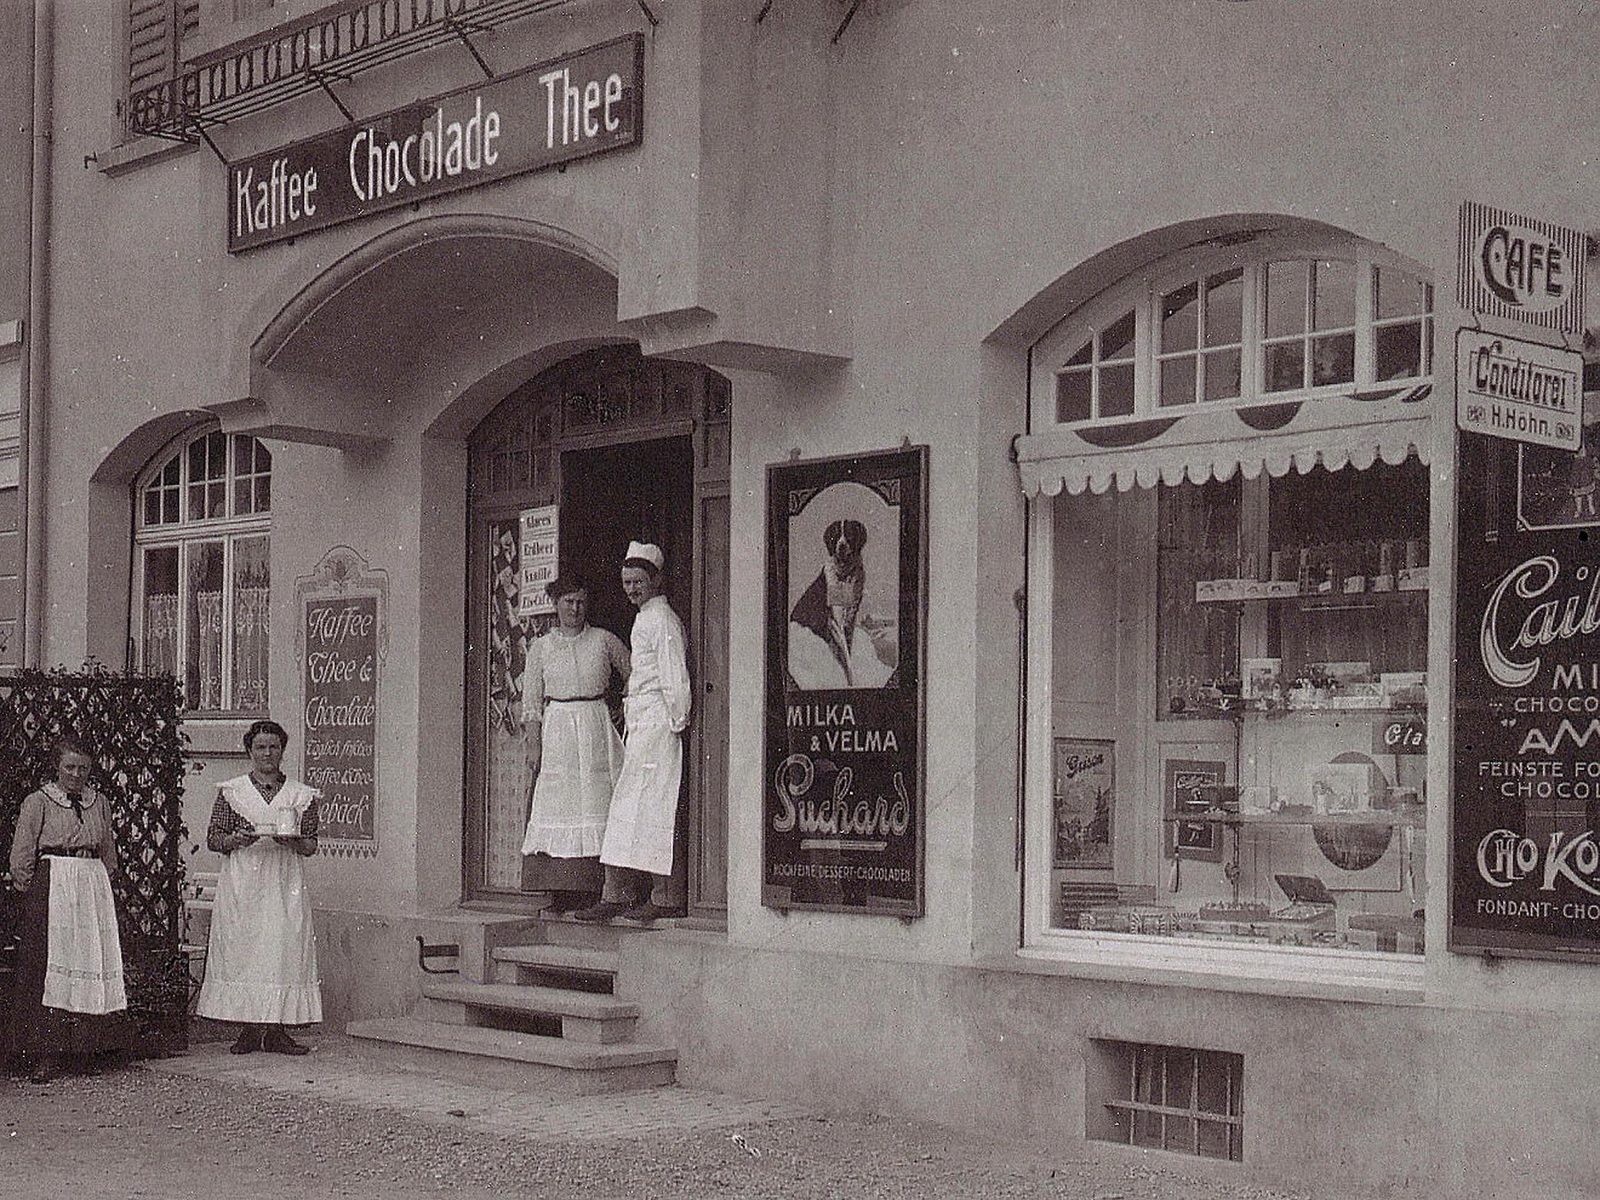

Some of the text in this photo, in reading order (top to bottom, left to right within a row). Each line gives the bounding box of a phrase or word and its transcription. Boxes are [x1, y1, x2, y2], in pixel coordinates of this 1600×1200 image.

[235, 68, 623, 237] Kaffee Chocolade Thee
[1476, 341, 1567, 408] Conditorei
[308, 607, 373, 646] Kaffee
[308, 651, 373, 683] Thee &
[305, 696, 375, 731] Chocolade
[786, 704, 856, 727] MILKA
[810, 731, 899, 753] & VELMA
[1479, 761, 1563, 777] FEINSTE
[320, 793, 370, 832] ebäck
[772, 753, 911, 837] Suchard
